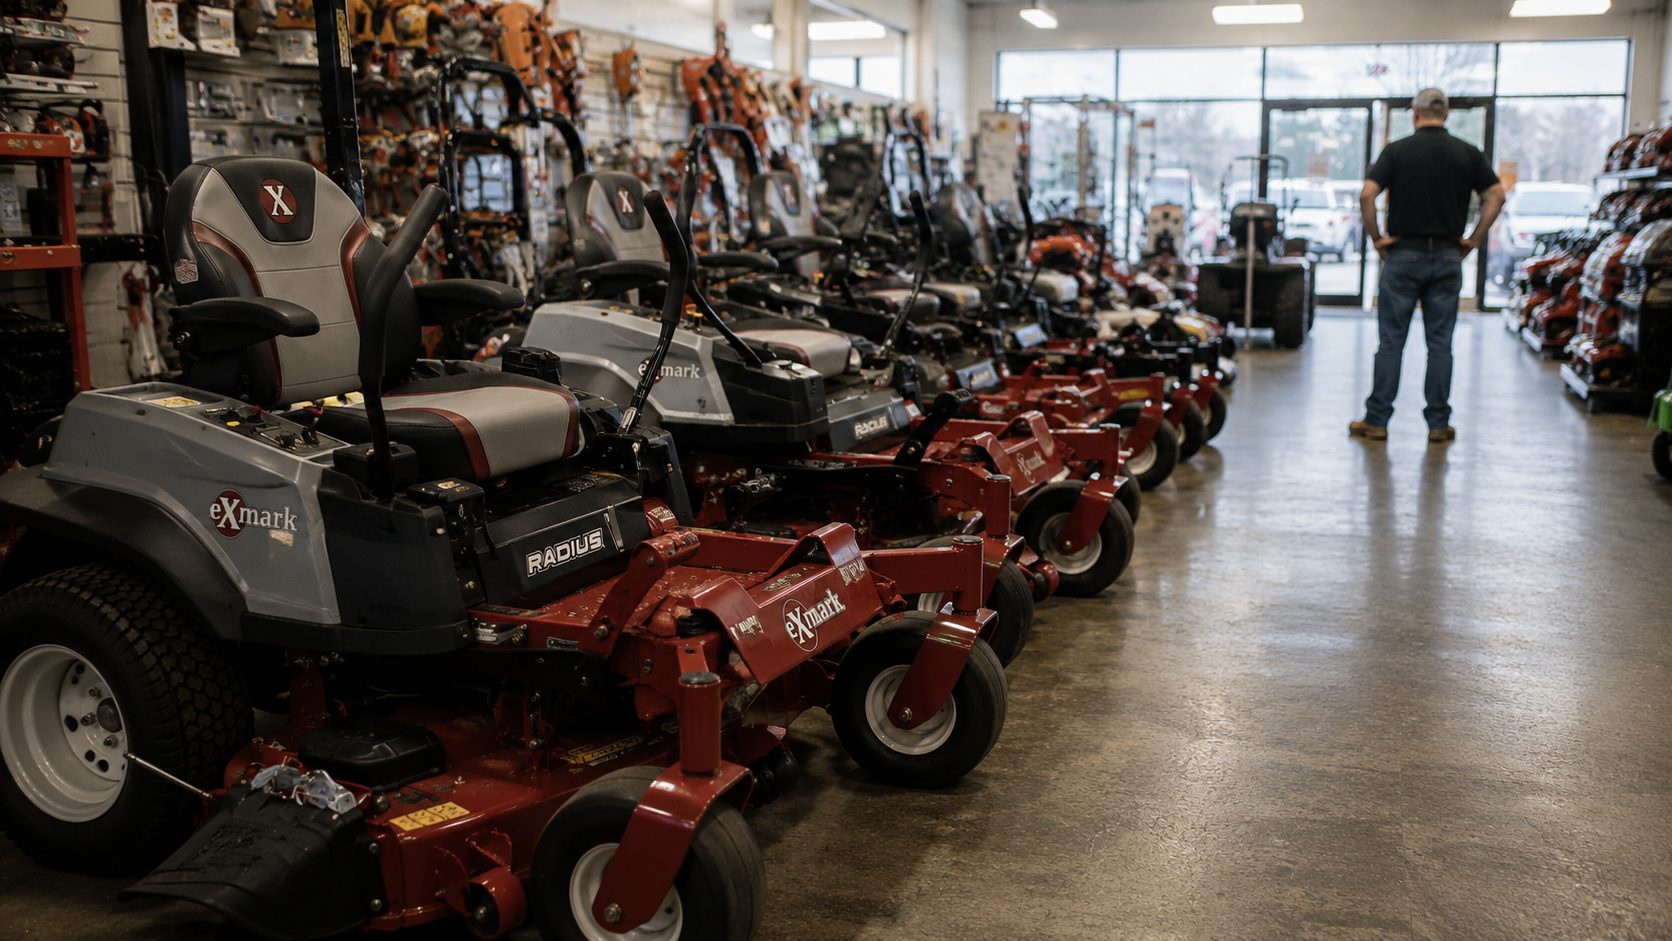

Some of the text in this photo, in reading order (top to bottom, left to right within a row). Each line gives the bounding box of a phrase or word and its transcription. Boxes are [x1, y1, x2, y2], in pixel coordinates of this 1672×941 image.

[263, 185, 294, 216] X
[618, 190, 634, 213] X
[638, 360, 700, 380] emark
[209, 496, 298, 531] eXmark
[526, 527, 604, 577] RADIUS
[784, 587, 846, 645] eXmark
